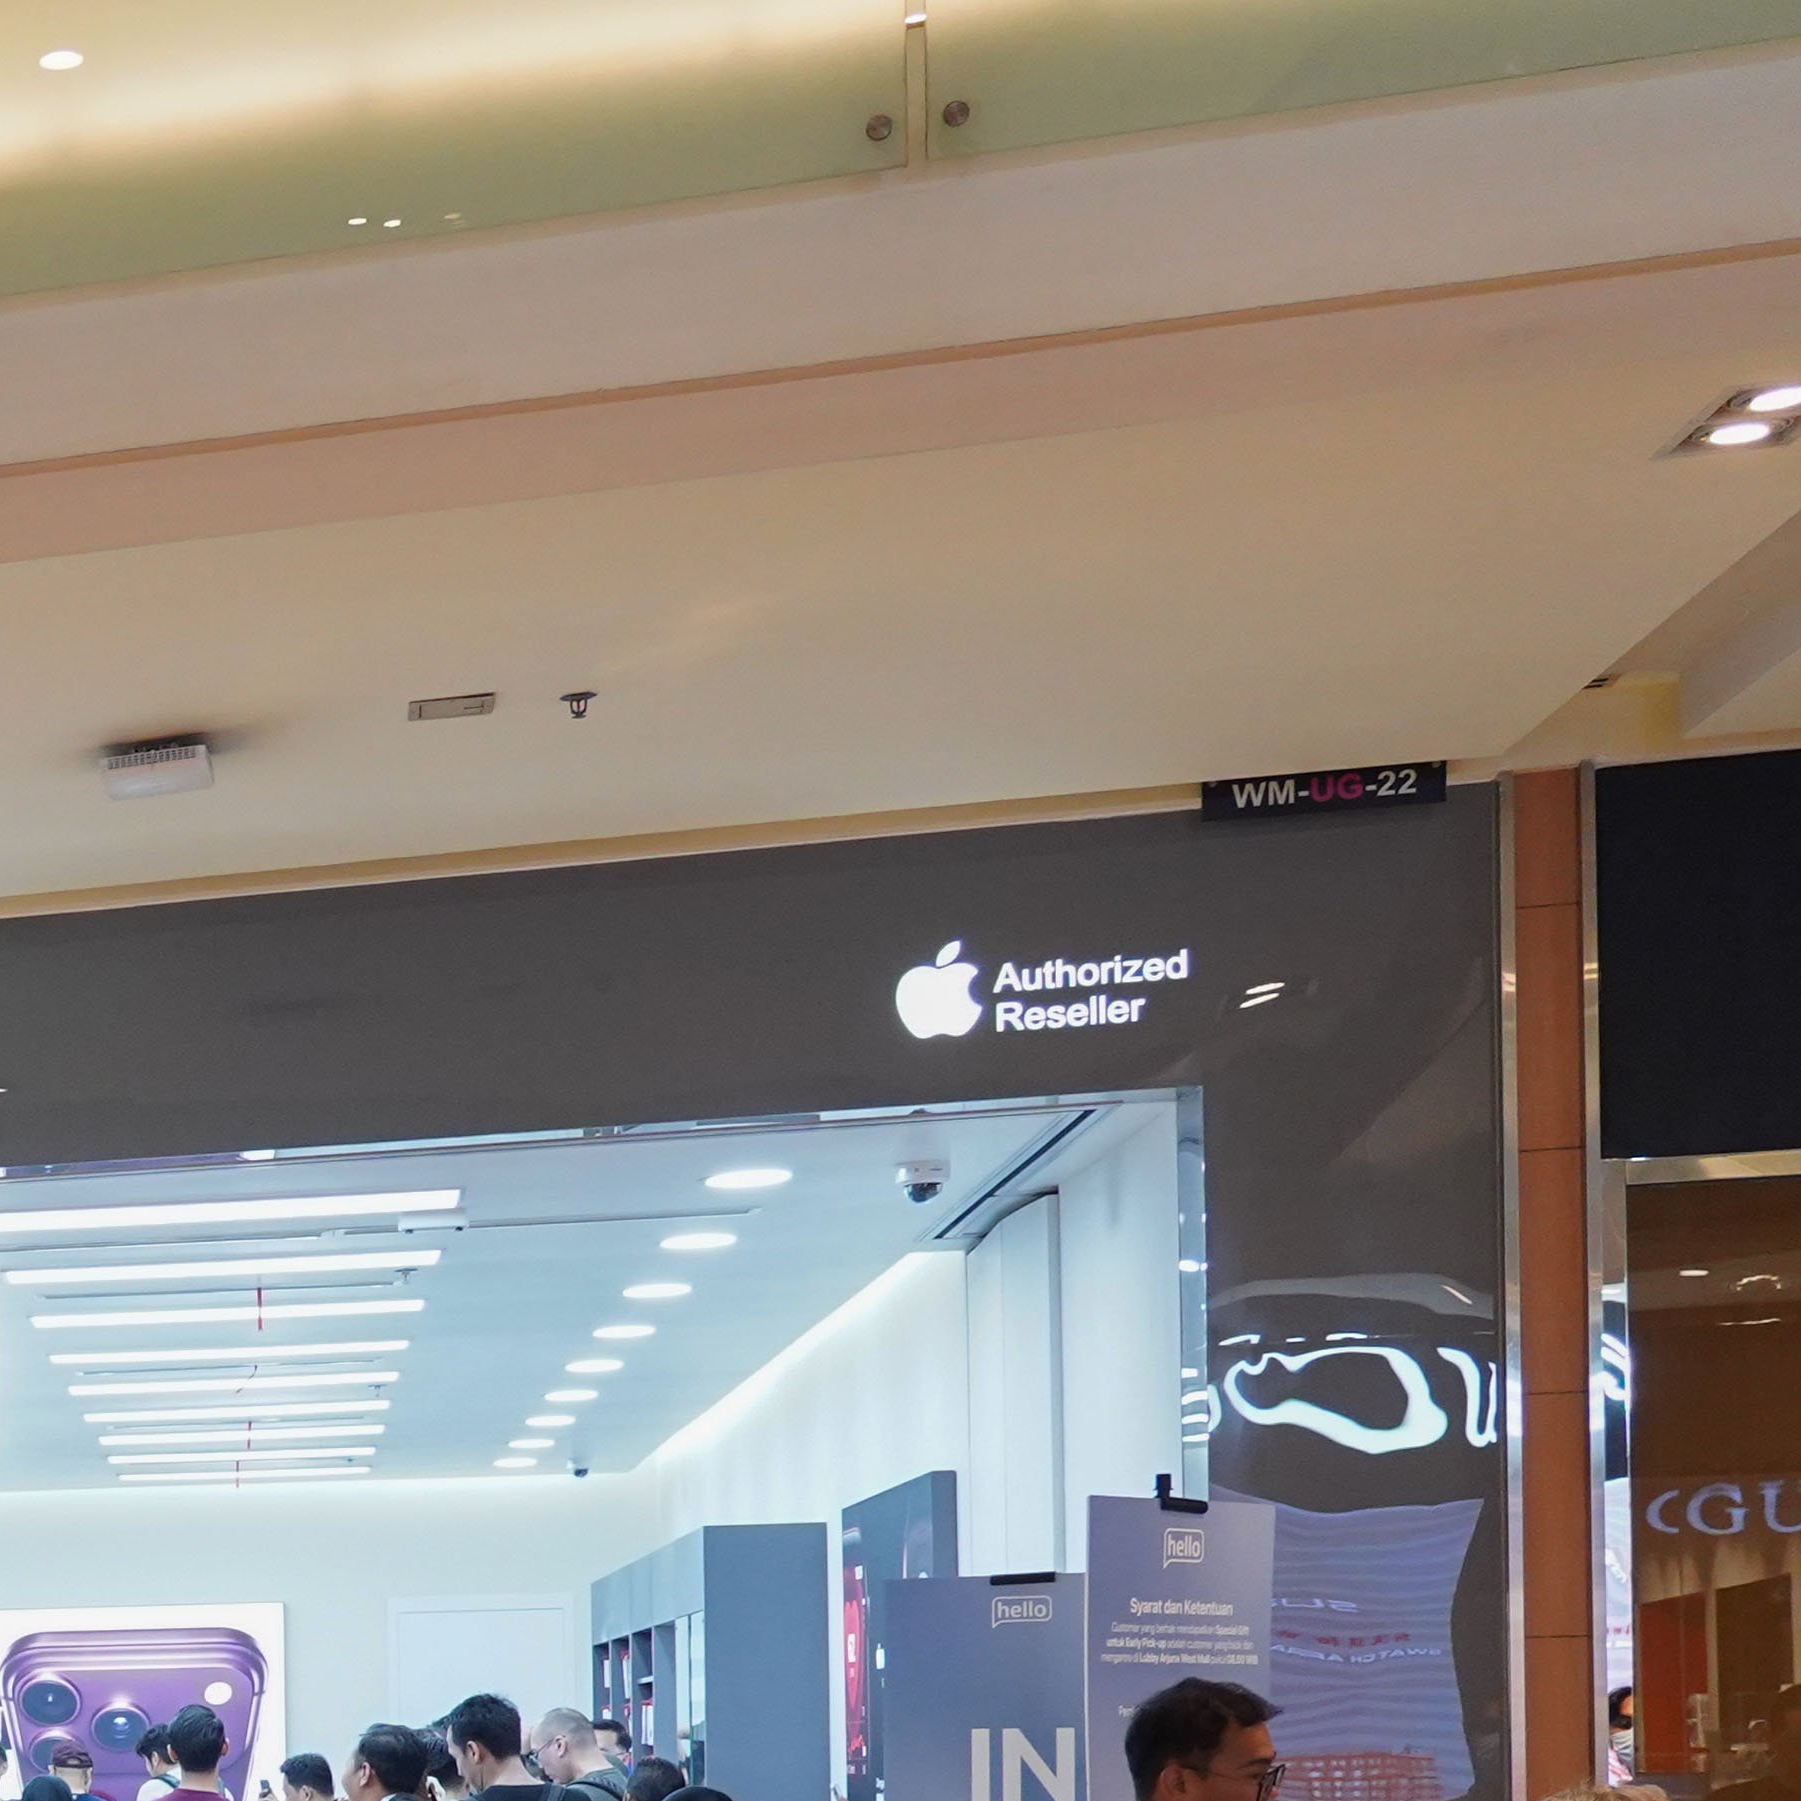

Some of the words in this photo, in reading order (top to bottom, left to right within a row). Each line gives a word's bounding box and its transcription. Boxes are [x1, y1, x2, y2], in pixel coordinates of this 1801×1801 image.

[1232, 769, 1418, 809] WM-UG-22
[992, 948, 1189, 996] Authorized
[994, 994, 1145, 1032] Reseller
[1167, 1534, 1201, 1558] hello
[997, 1601, 1048, 1619] hello
[1130, 1597, 1162, 1616] Syarat
[1163, 1599, 1183, 1614] dan
[1184, 1600, 1234, 1616] Ketentuan
